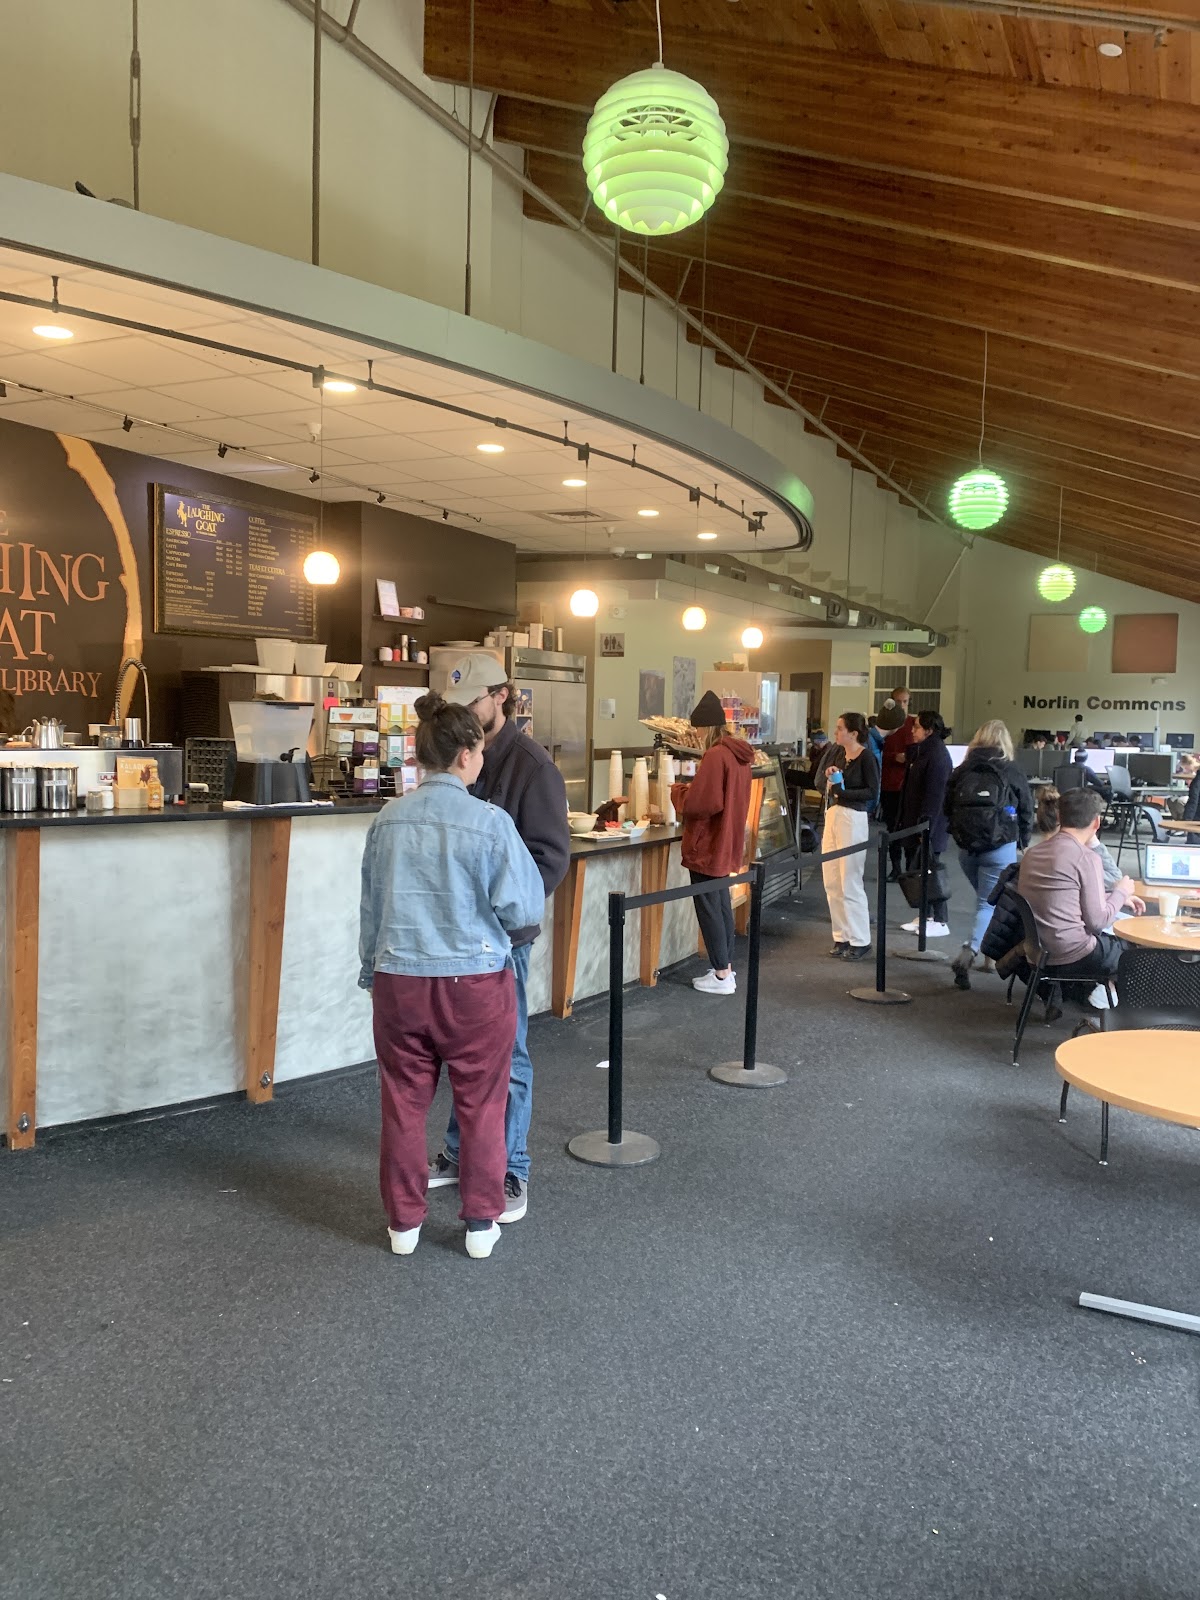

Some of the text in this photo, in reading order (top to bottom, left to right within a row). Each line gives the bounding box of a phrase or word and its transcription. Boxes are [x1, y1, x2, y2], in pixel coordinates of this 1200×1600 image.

[188, 506, 225, 522] LAUGHING
[166, 528, 191, 538] ESPRESSO
[196, 520, 217, 533] GOAT
[0, 607, 56, 660] AT
[883, 643, 895, 653] EXIT
[1, 668, 102, 698] LIBRARY
[1023, 695, 1186, 711] Norlin Commons
